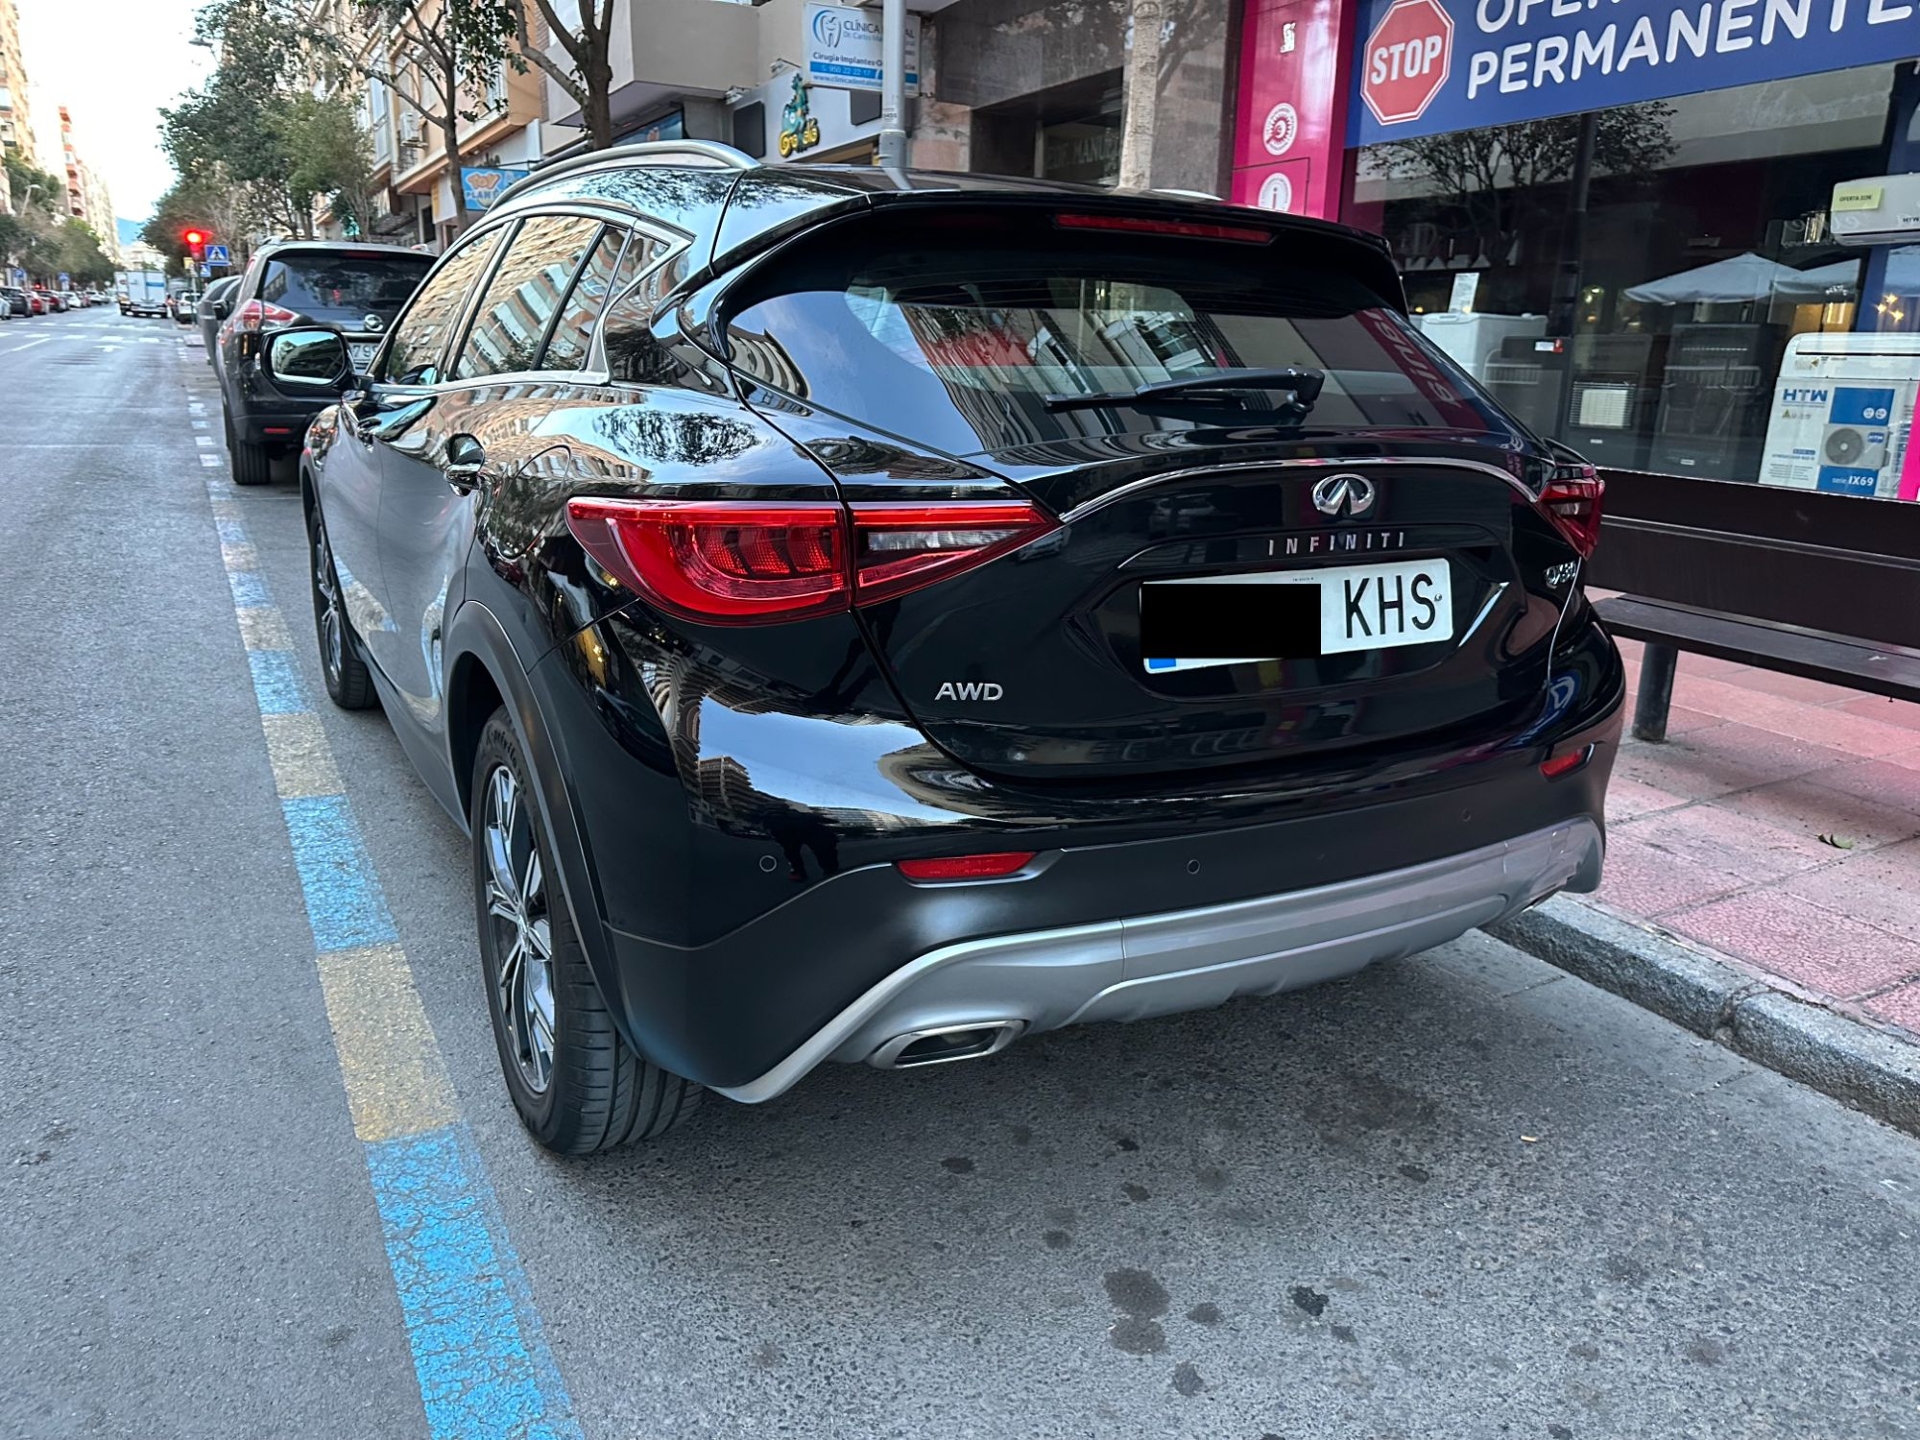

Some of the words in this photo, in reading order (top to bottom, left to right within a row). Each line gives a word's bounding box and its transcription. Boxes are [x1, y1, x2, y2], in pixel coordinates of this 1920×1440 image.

[843, 19, 880, 35] CLÍNICA
[1371, 35, 1442, 85] STOP
[1848, 475, 1874, 487] IX69
[1268, 532, 1404, 556] INFINITI
[1344, 573, 1436, 639] KHS
[934, 682, 1004, 701] AWD
